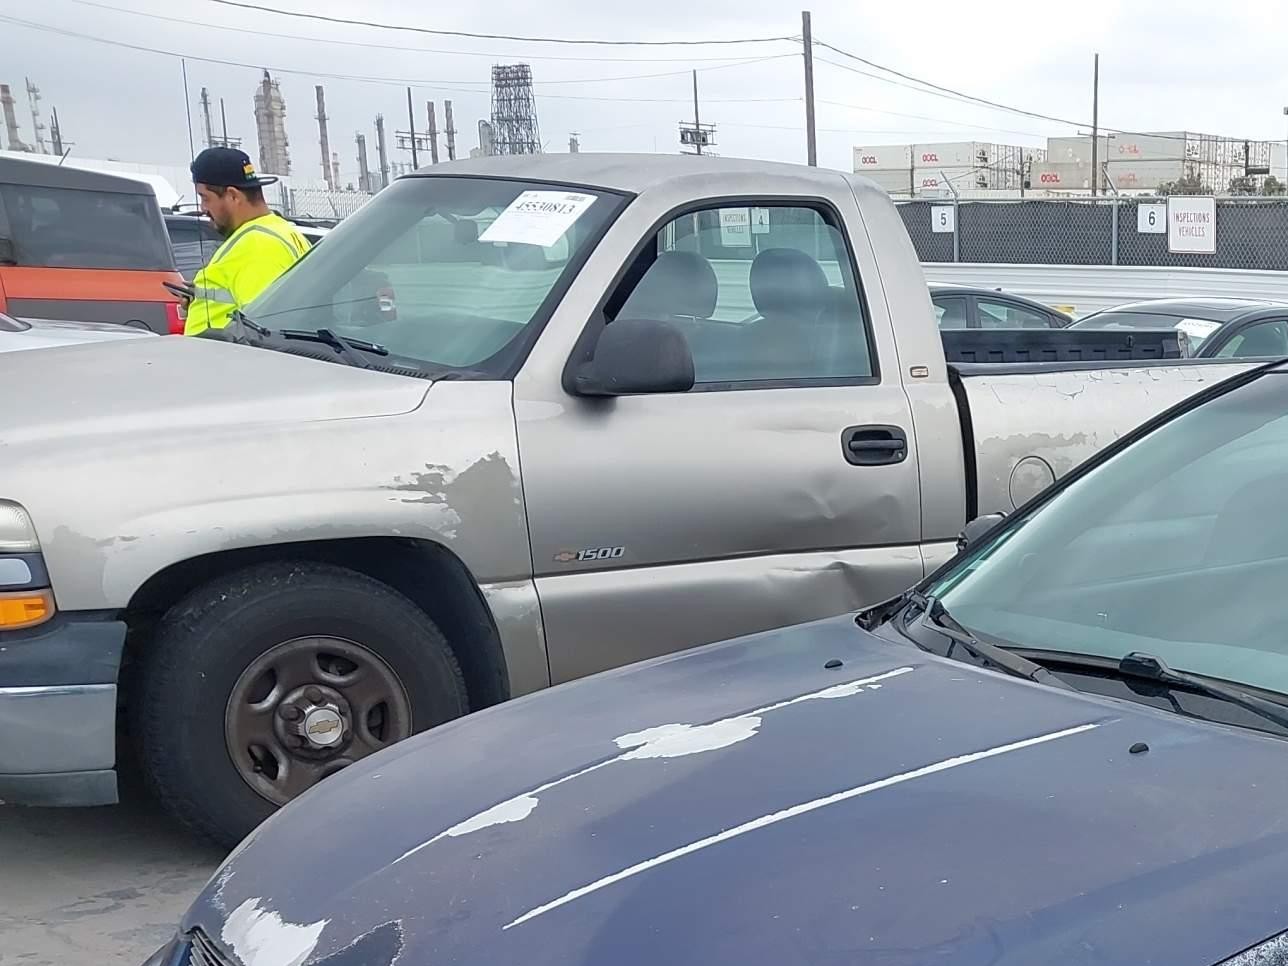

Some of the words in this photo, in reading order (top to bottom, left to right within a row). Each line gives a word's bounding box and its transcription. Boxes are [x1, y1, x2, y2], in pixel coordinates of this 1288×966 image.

[861, 156, 877, 164] OOCL
[922, 154, 938, 163] OOCL
[1040, 174, 1060, 183] OOCL
[940, 213, 947, 226] 5
[1148, 211, 1156, 226] 6
[1173, 212, 1210, 223] INSPECTIONS
[1179, 226, 1205, 237] VEHICLES
[578, 546, 625, 560] 1500
